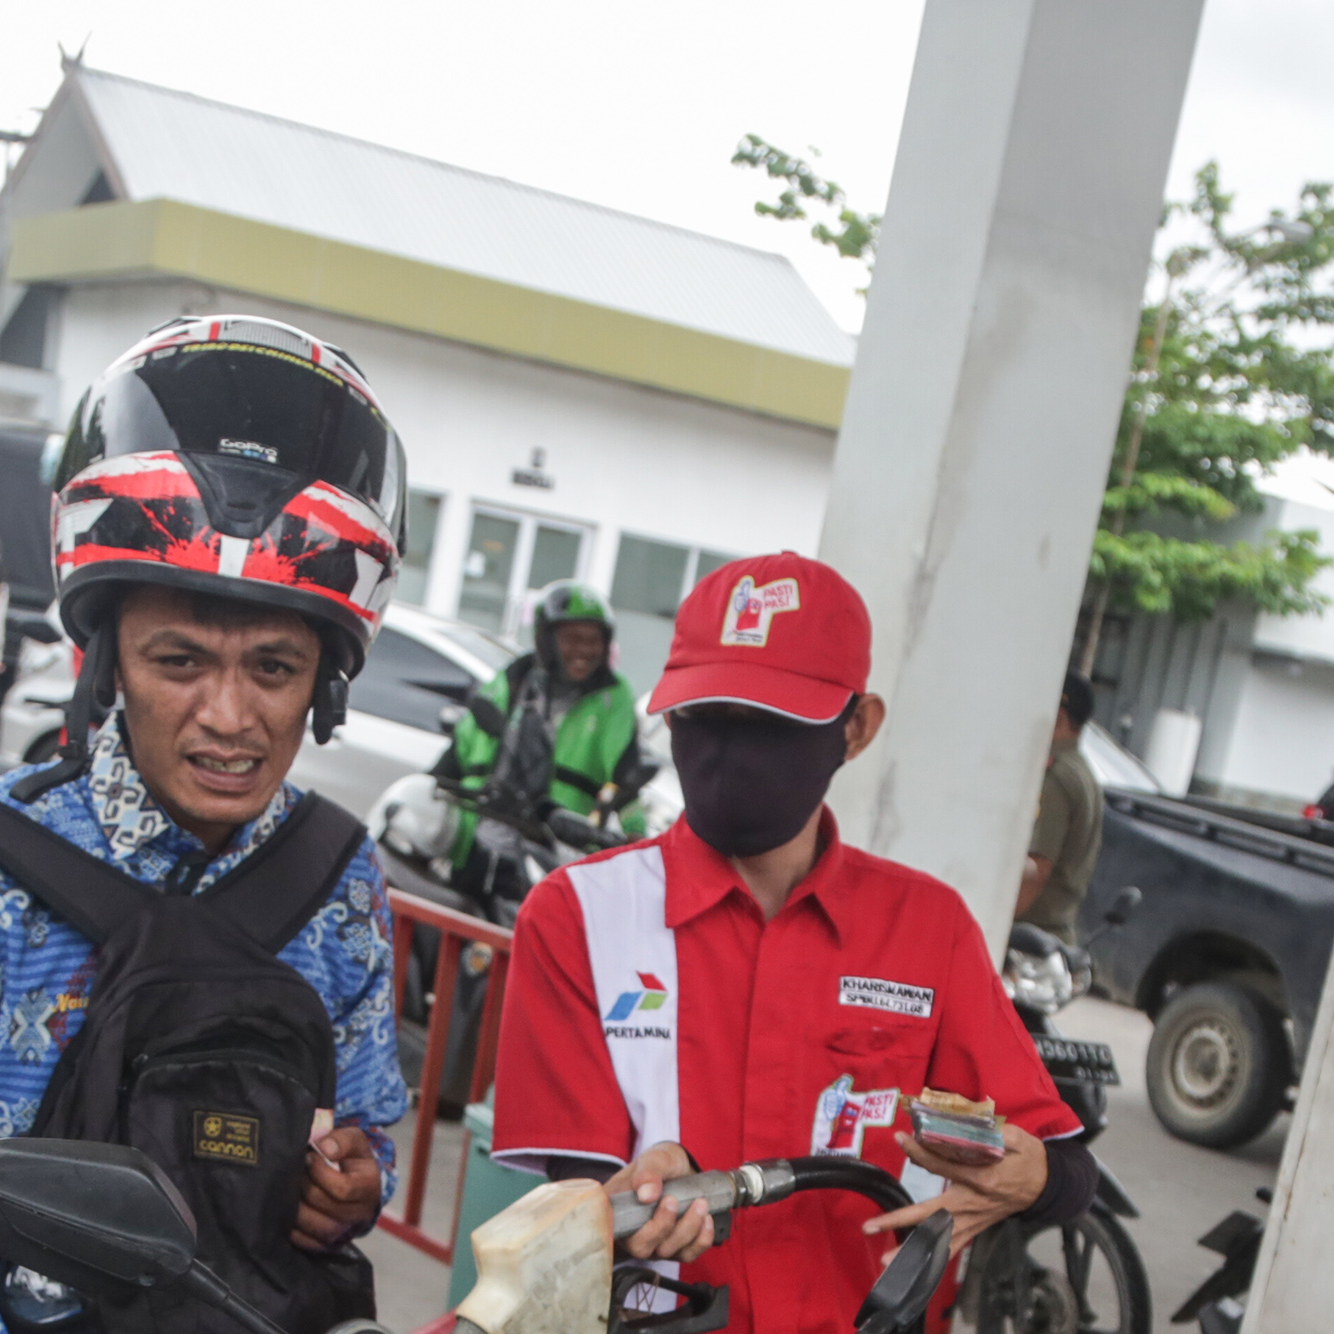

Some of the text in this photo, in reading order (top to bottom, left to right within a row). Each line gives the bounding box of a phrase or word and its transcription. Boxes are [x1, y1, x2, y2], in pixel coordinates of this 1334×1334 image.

[220, 438, 278, 457] GoPro
[605, 1026, 671, 1040] PERTAMINA
[200, 1140, 254, 1159] cannon
